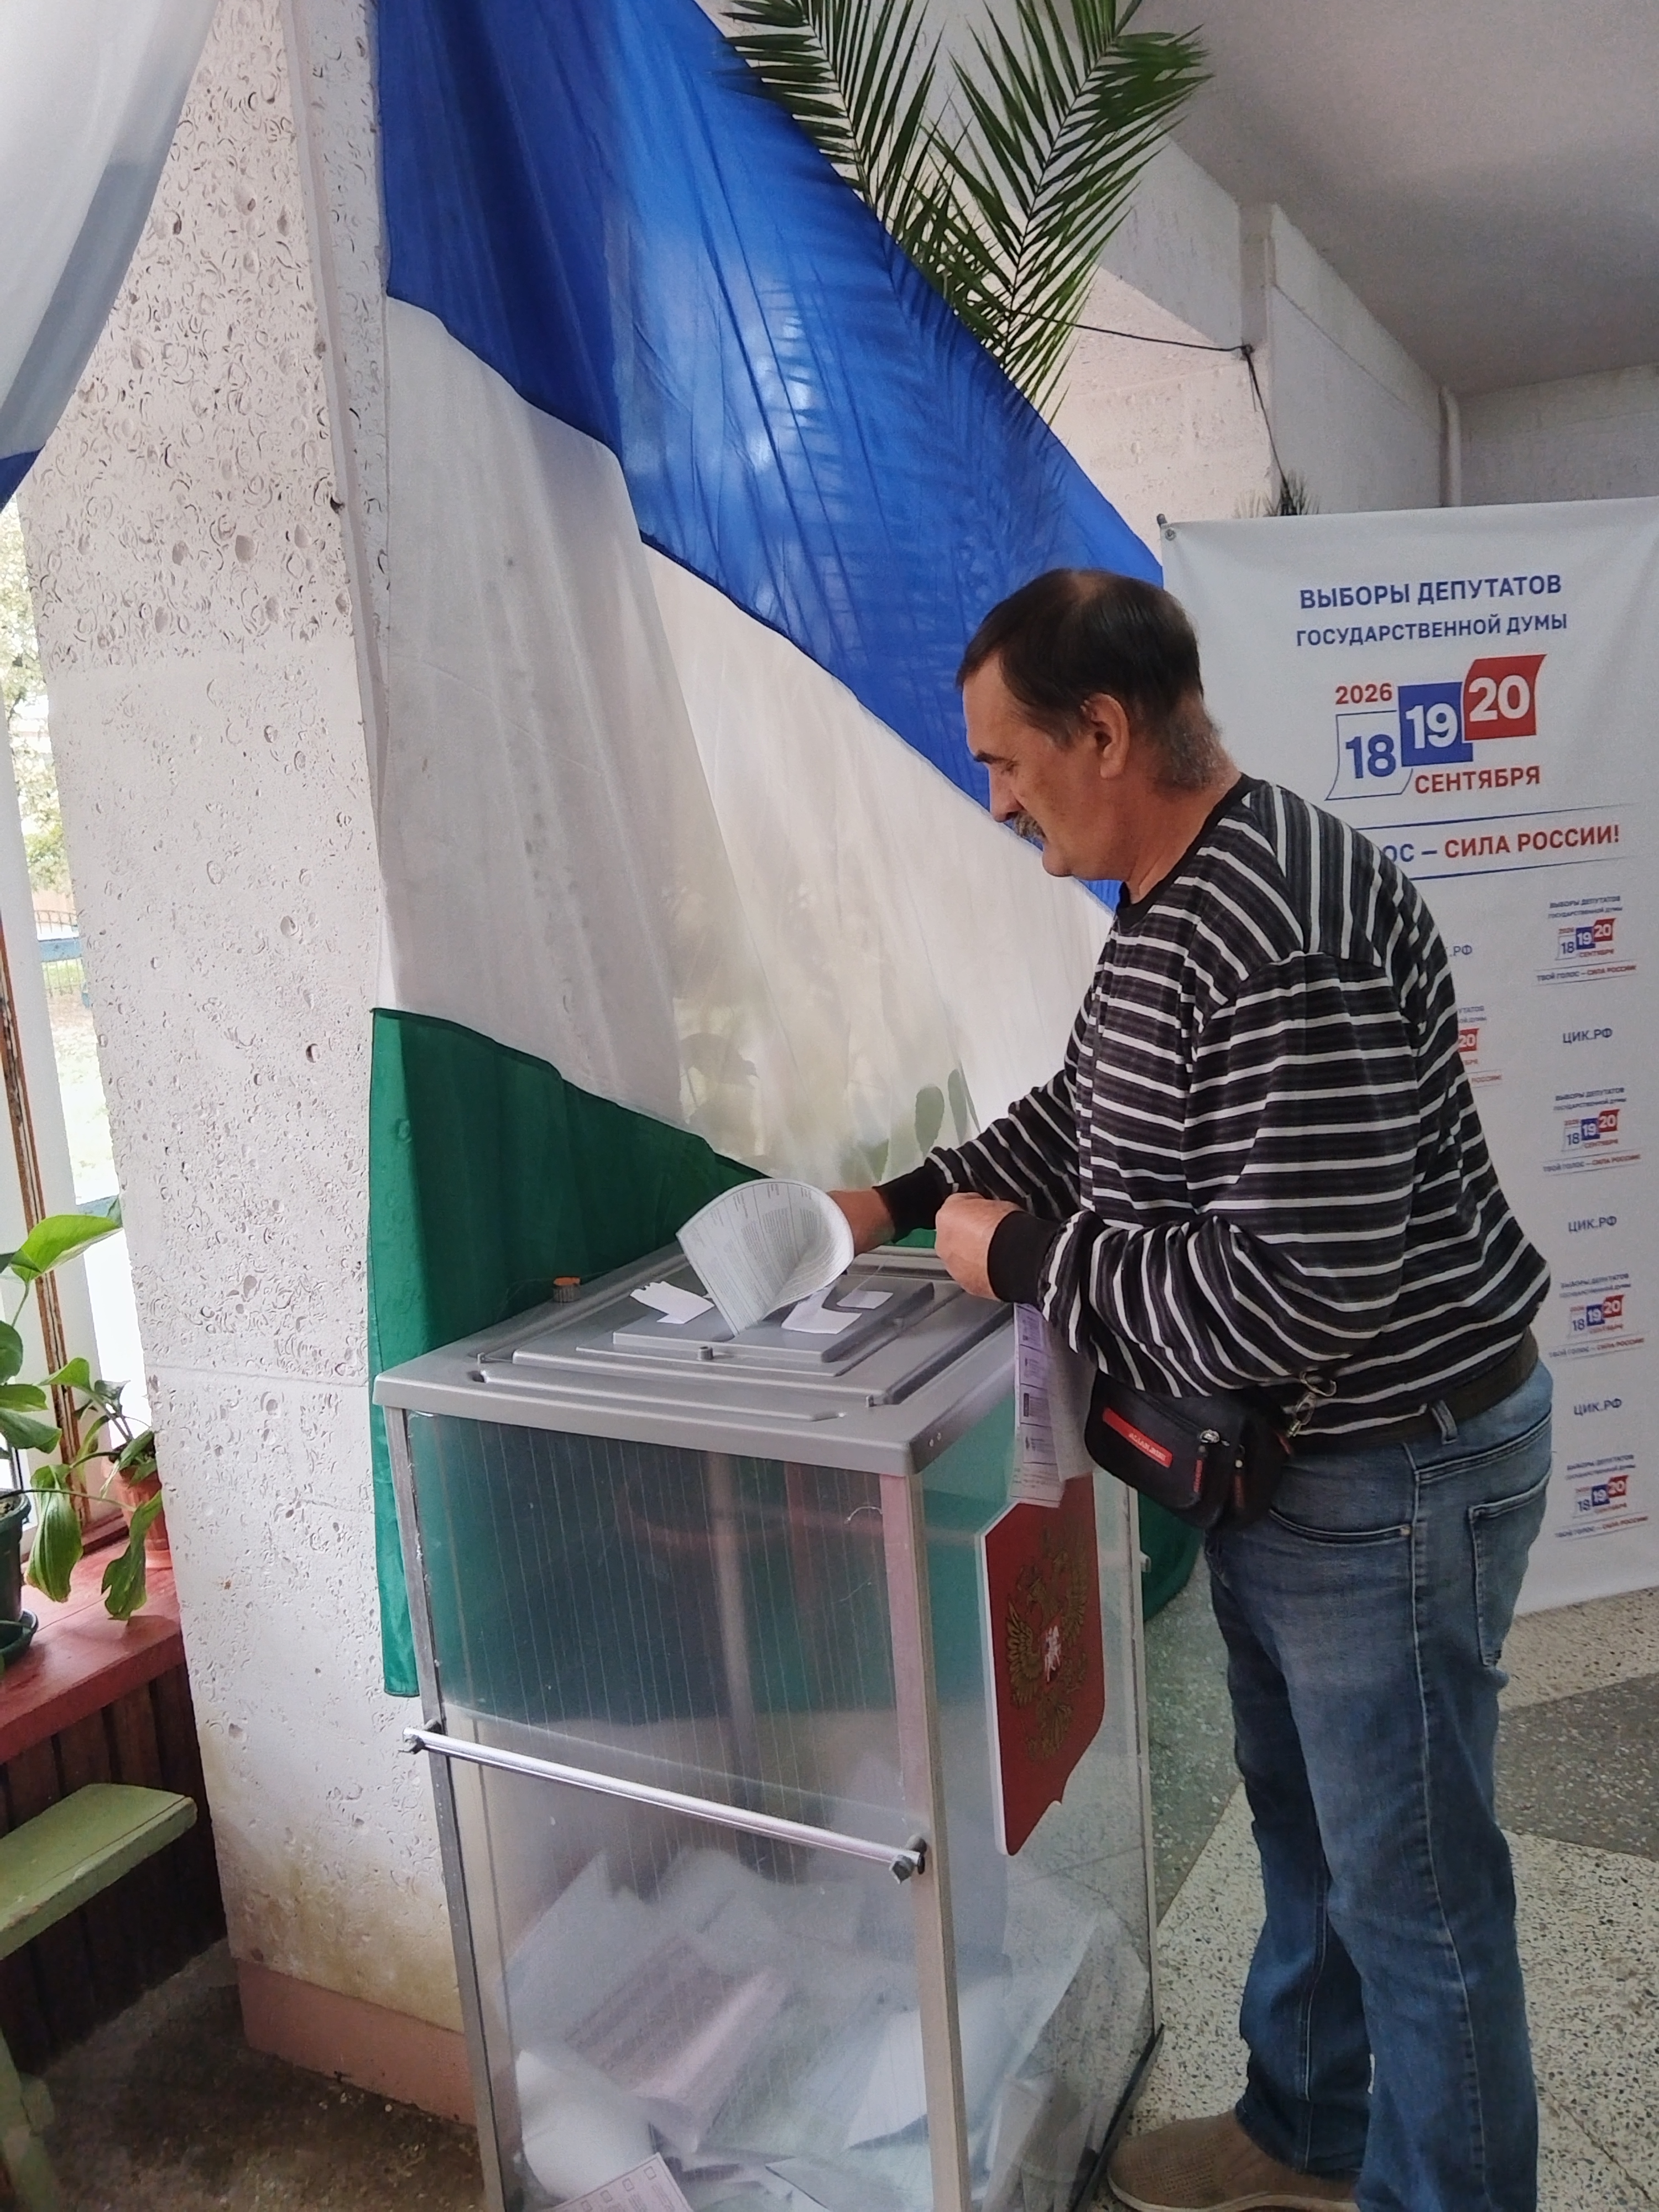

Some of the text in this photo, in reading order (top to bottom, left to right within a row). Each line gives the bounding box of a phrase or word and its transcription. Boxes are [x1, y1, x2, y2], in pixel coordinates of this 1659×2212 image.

[1300, 575, 1562, 609] ВЫБОРЫ ДЕПУТАТОВ
[1296, 614, 1567, 646] ГОСУДАРСТВЕННОЙ ДУМЫ
[1335, 684, 1392, 705] 2026
[1345, 675, 1531, 779] 18 19 20
[1415, 765, 1541, 794] СЕНТЯБРЯ
[1444, 836, 1510, 858] СИЛА
[1517, 824, 1619, 851] РОССИИ!
[1561, 924, 1611, 954] 18 19 20
[1459, 1034, 1475, 1047] 20
[1562, 1027, 1613, 1044] ЦИК.РФ
[1567, 1114, 1616, 1145] 18 19 20
[1568, 1215, 1617, 1233] ЦИК.РФ
[1572, 1318, 1585, 1331] 18
[1588, 1308, 1602, 1322] 19
[1604, 1300, 1621, 1314] 20
